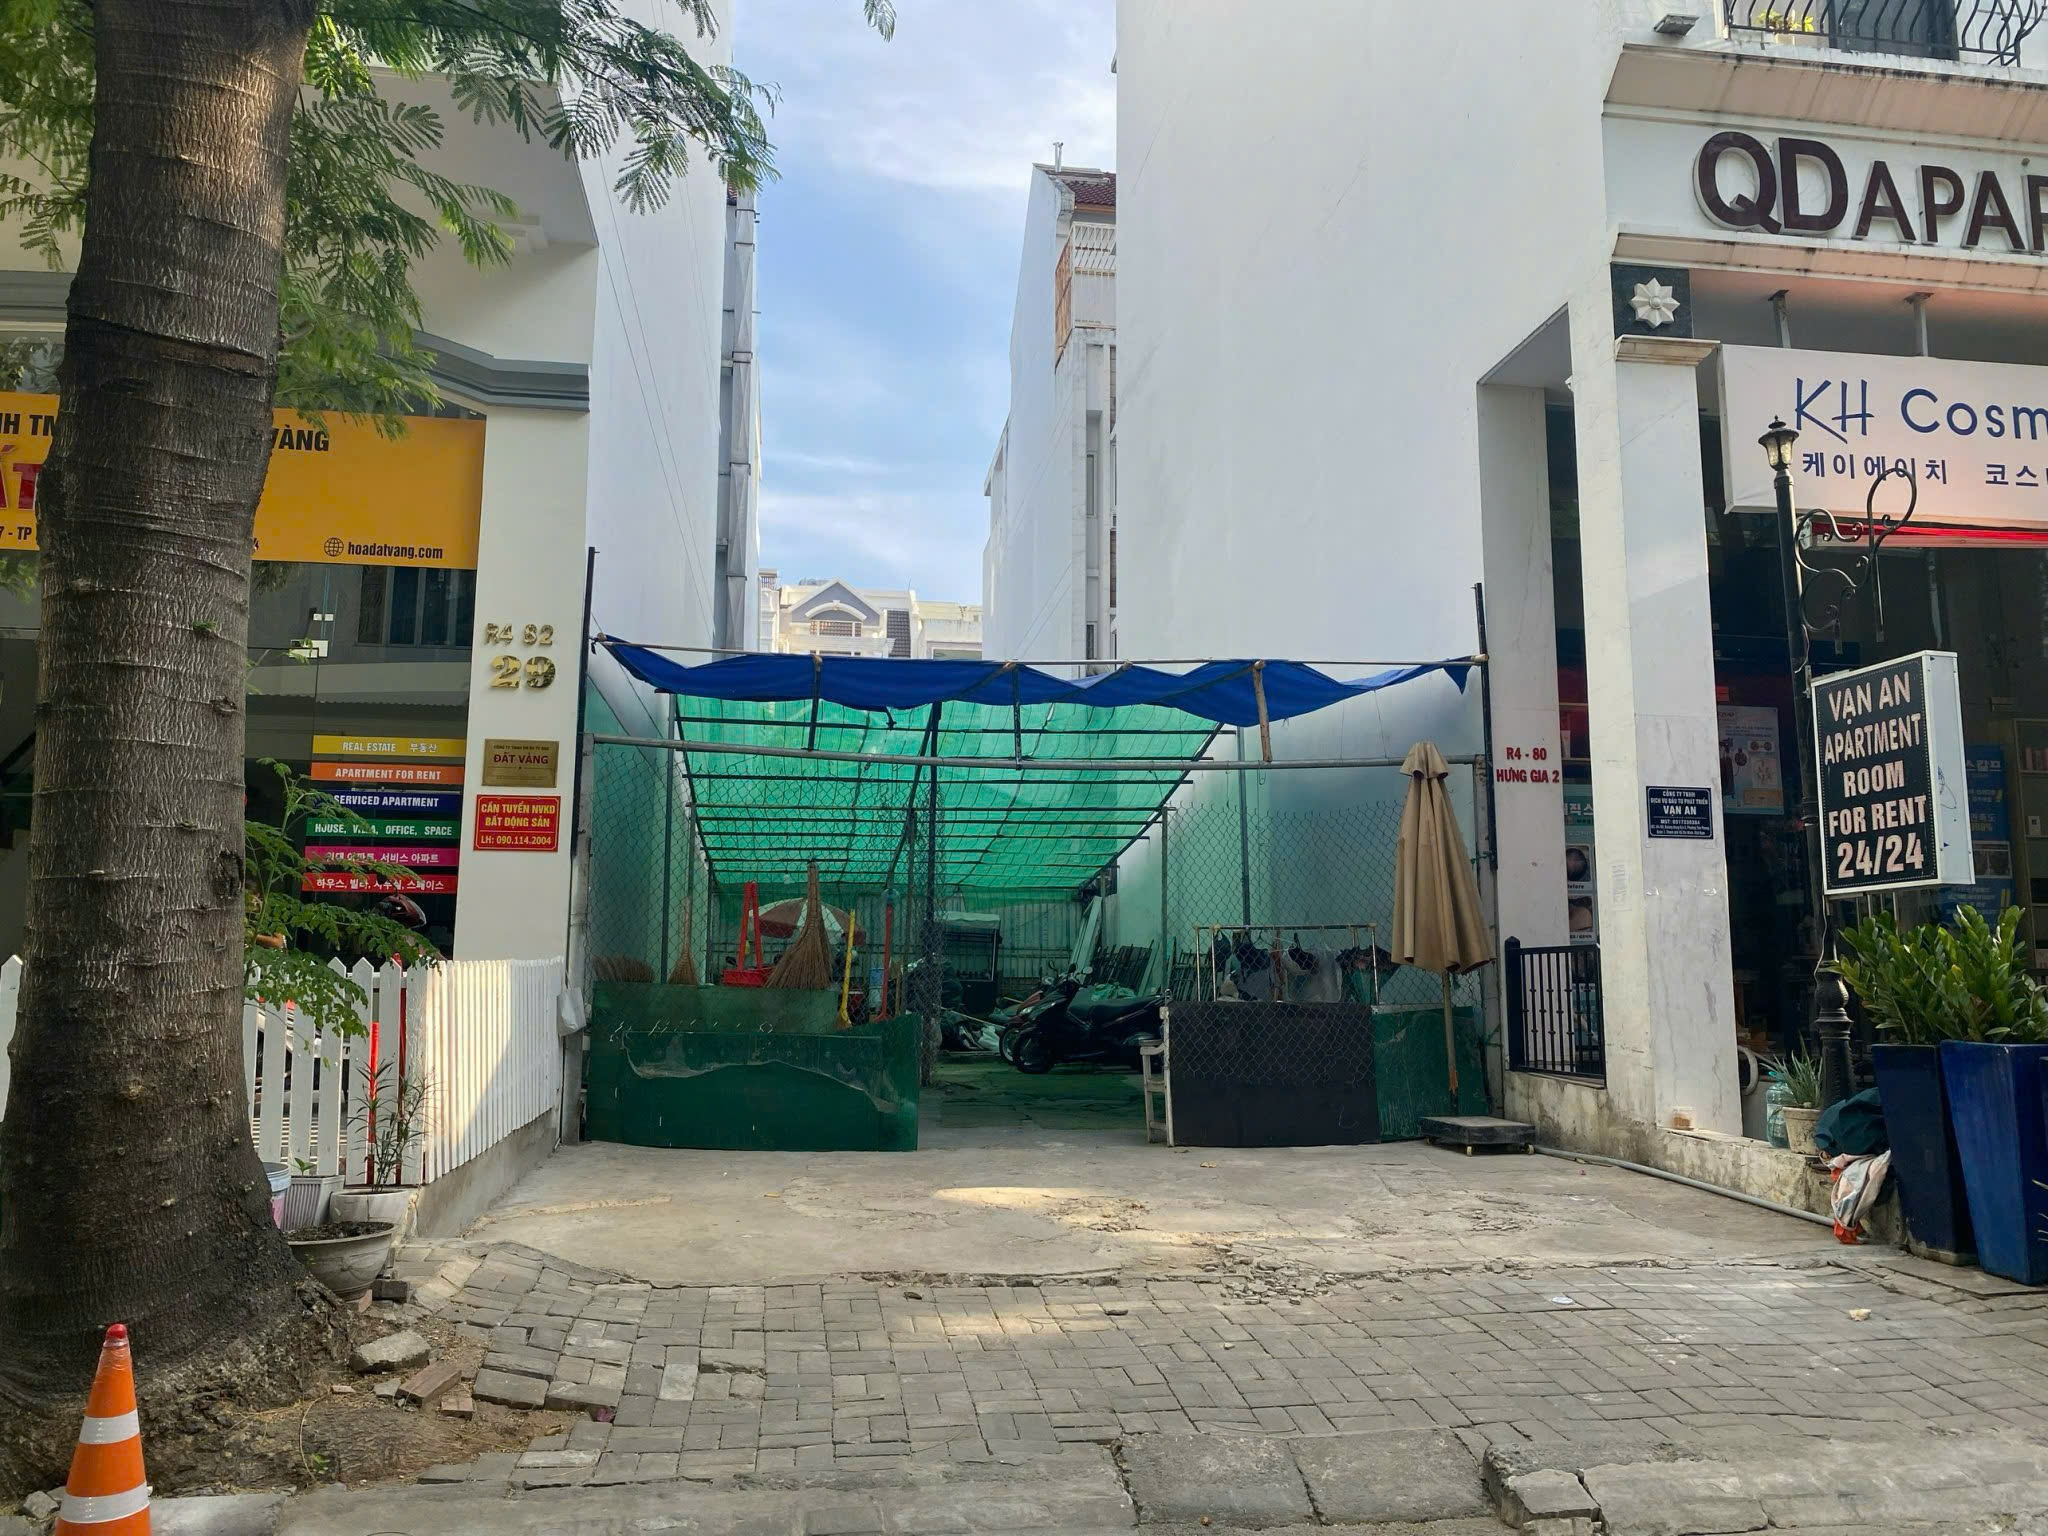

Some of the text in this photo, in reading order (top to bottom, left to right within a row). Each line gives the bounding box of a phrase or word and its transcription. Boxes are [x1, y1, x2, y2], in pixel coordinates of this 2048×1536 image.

[1794, 377, 1875, 444] KH
[0, 413, 20, 434] H
[1802, 451, 2048, 487] 케이에이치 코스
[17, 526, 32, 540] TP
[348, 541, 443, 559] hoadatvang.com
[485, 623, 514, 646] R4
[491, 655, 556, 689] 29
[1828, 671, 1911, 725] VẠN AN
[342, 741, 396, 752] REAL ESTATE
[1824, 712, 1921, 766] APARTMENT
[1506, 747, 1521, 760] R4
[1532, 747, 1547, 760] 80
[335, 768, 441, 780] APARTMENT FOR RENT
[1496, 767, 1560, 784] HƯNG GIA 2
[1843, 760, 1905, 798] ROOM
[333, 794, 439, 807] SERVICED APARTMENT
[1663, 805, 1697, 817] VẠN AN
[1828, 794, 1927, 837] FOR RENT
[385, 825, 418, 836] OFFICE,
[424, 826, 452, 836] SPACE
[481, 835, 551, 845] LH: 090.114.2004
[380, 853, 409, 863] 서비스
[411, 853, 439, 863] 아파트
[1837, 832, 1924, 879] 24/24
